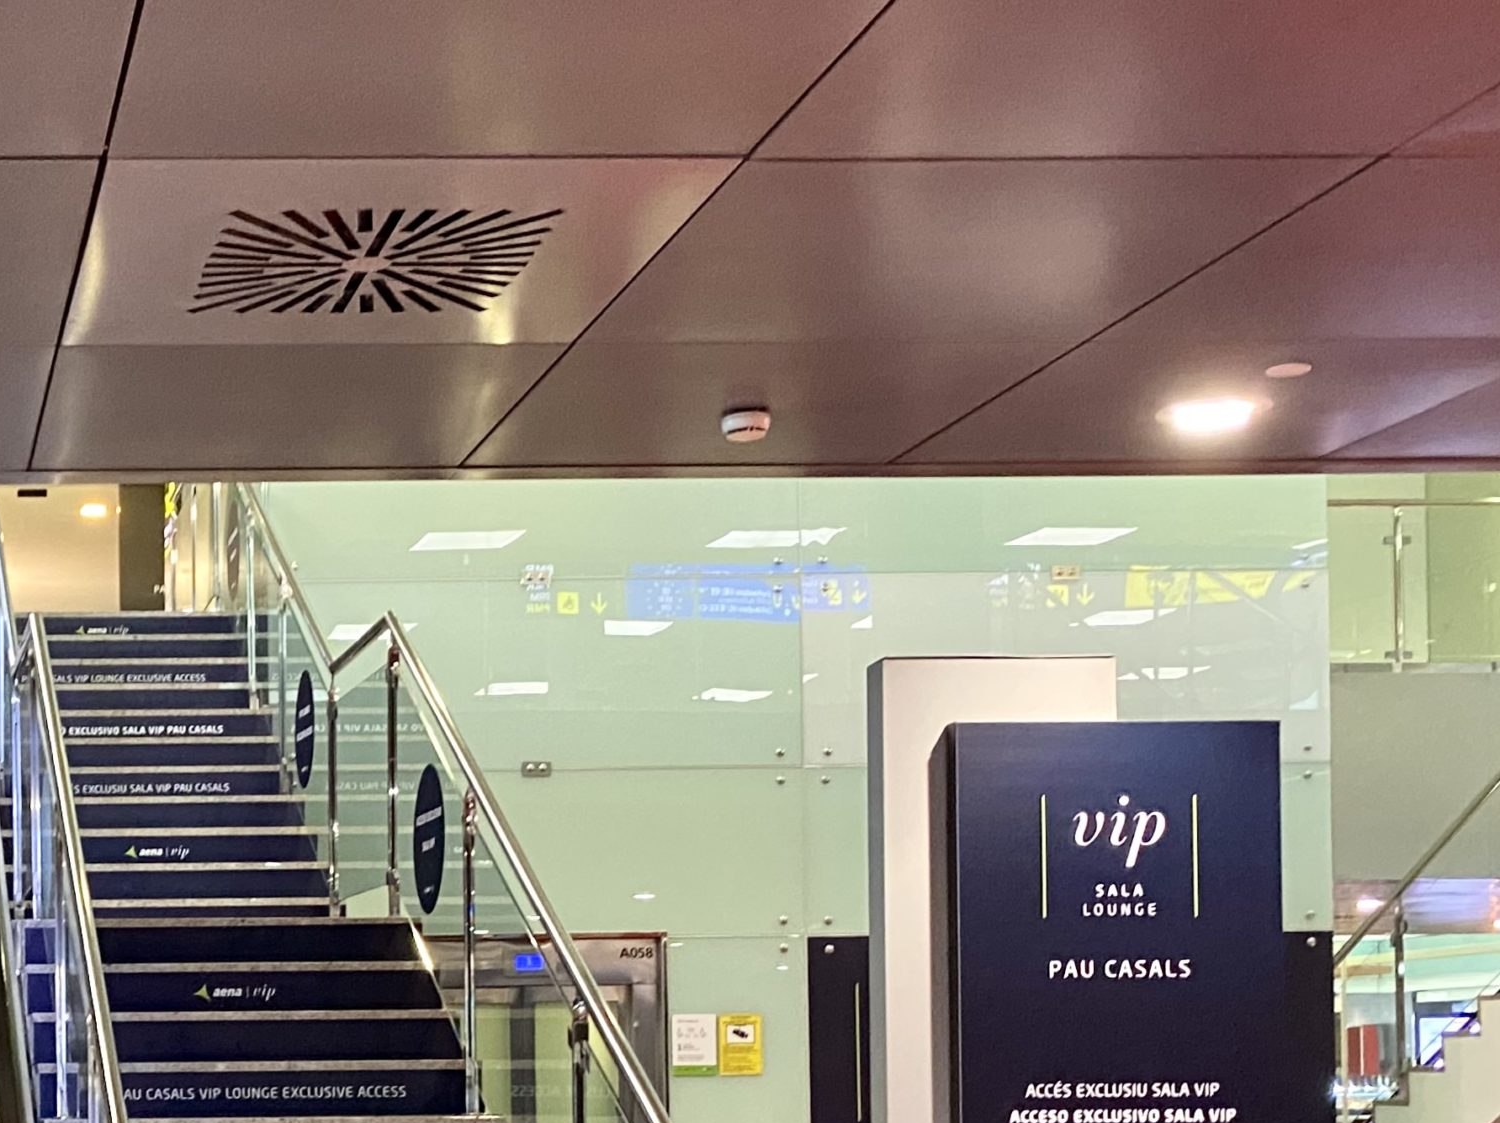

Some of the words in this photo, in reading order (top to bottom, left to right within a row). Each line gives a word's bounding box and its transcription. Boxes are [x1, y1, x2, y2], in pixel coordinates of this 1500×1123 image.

[127, 674, 172, 682] EXCLUSIVE
[174, 674, 206, 682] ACCESS
[69, 726, 119, 735] EXCLUSIVO
[123, 726, 145, 734] SALA
[148, 726, 164, 734] VIP
[167, 726, 186, 734] PAU
[189, 725, 224, 733] CASALS
[82, 784, 127, 793] EXCLUSIU
[130, 784, 154, 793] SALA
[156, 784, 172, 792] VIP
[174, 783, 193, 792] PAU
[195, 783, 230, 792] CASALS
[1073, 795, 1165, 868] vip
[139, 847, 162, 856] aena
[171, 847, 189, 859] vip
[1096, 883, 1143, 897] SALA
[1083, 903, 1156, 916] LOUNGE
[620, 948, 653, 958] A058
[1049, 959, 1094, 978] PAU
[1105, 959, 1191, 978] CASALS
[213, 987, 243, 998] aena
[253, 984, 275, 1002] vip
[124, 1088, 141, 1100] AU
[146, 1088, 195, 1100] CASALS
[200, 1087, 221, 1099] VIP
[225, 1087, 278, 1099] LOUNGE
[282, 1086, 352, 1098] EXCLUSIVE
[358, 1085, 406, 1098] ACCESS
[1025, 1081, 1071, 1098] ACCÉS
[1076, 1083, 1147, 1098] EXCLUSIU
[1152, 1083, 1189, 1097] SALA
[1194, 1082, 1220, 1097] VIP
[1009, 1109, 1068, 1123] ACCESO
[1073, 1109, 1160, 1123] EXCLUSIVO
[1164, 1108, 1204, 1123] SALA
[1209, 1108, 1237, 1123] VIP
